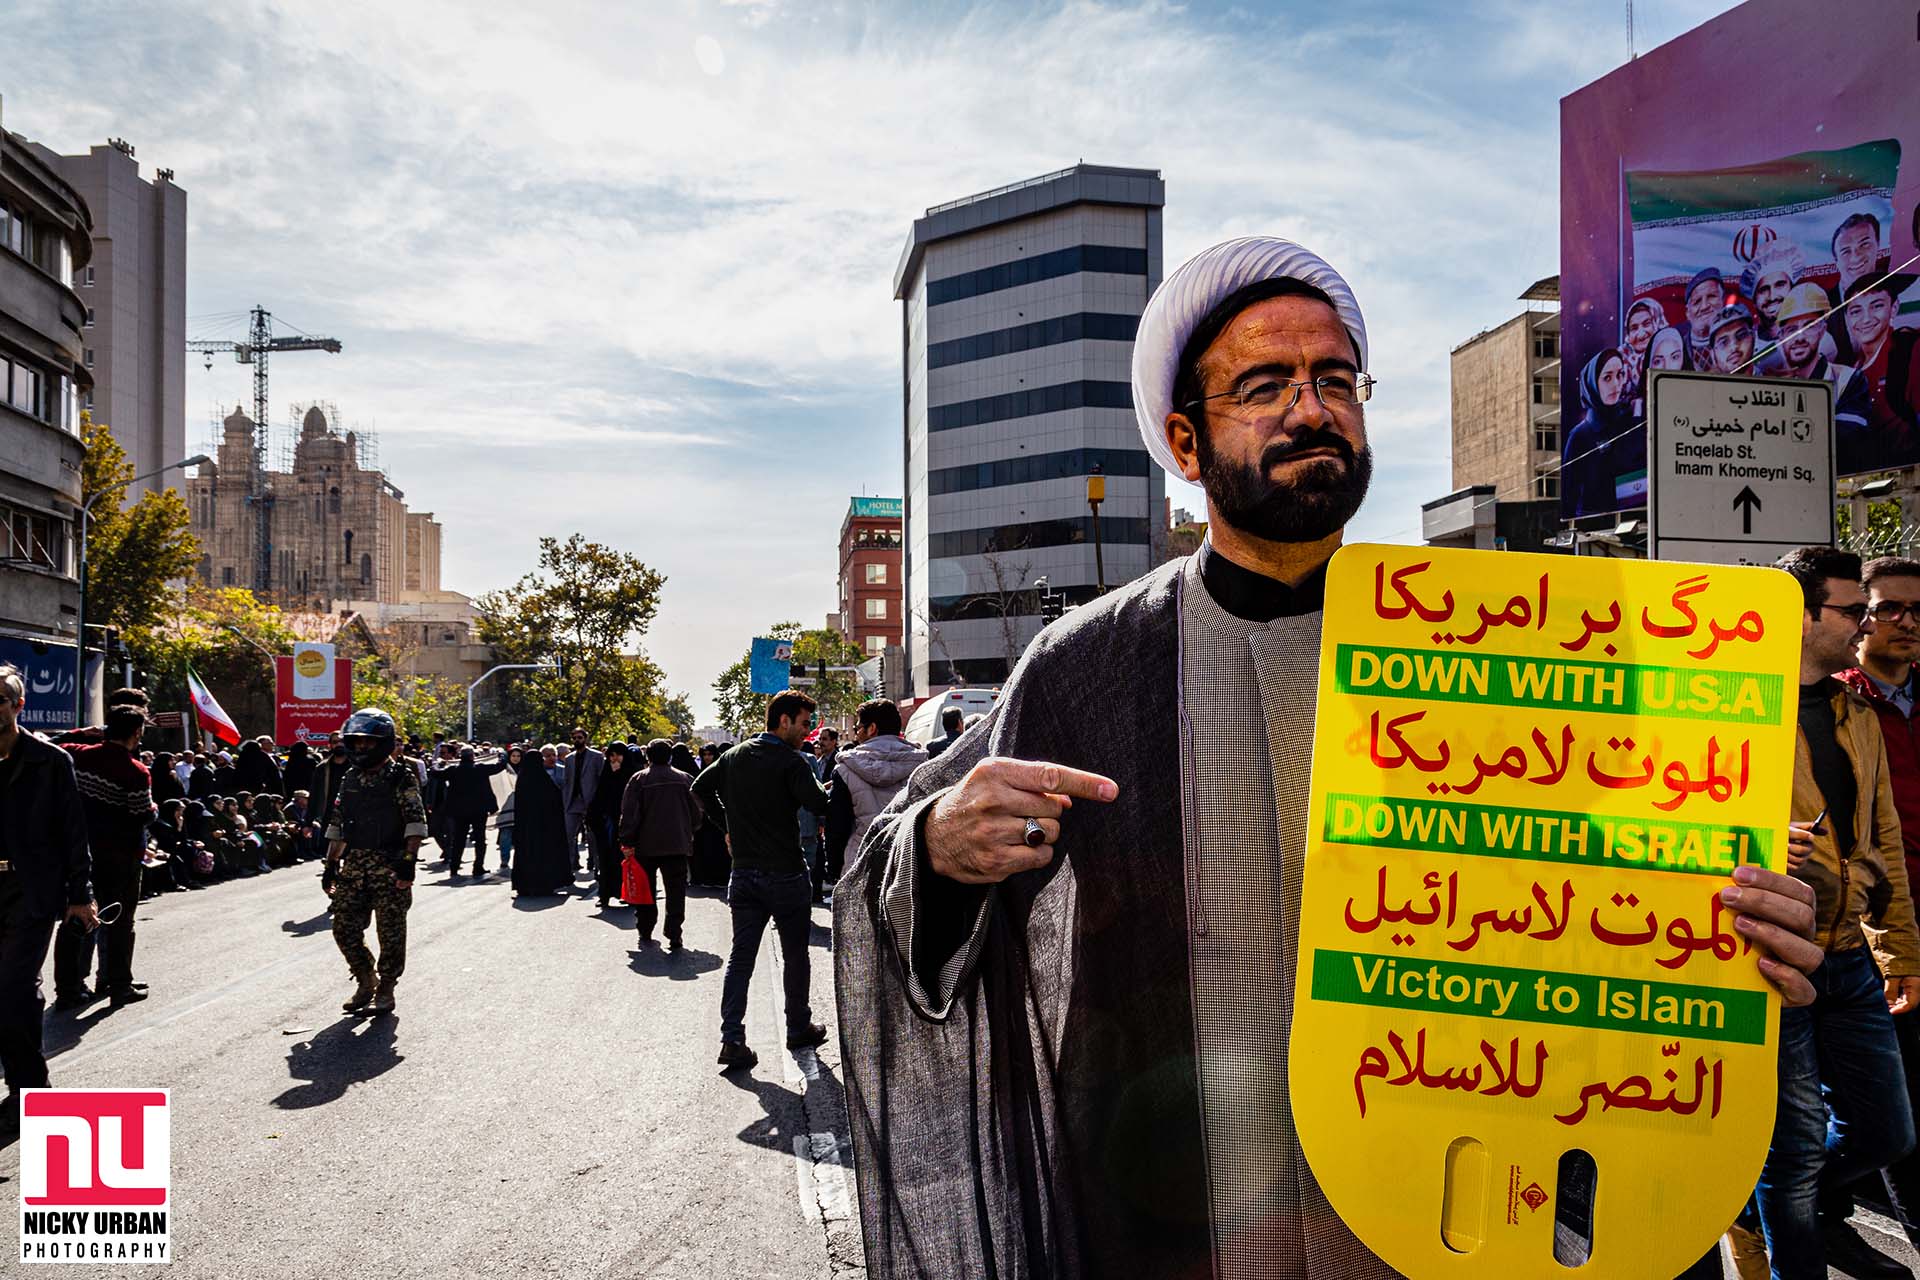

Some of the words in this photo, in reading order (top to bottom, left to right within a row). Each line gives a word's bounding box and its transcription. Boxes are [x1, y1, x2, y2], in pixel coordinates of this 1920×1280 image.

[1692, 417, 1745, 438] خمینی
[1729, 391, 1786, 409] انقلاب
[1750, 419, 1786, 441] امام
[1675, 442, 1733, 459] Enqelab
[1737, 445, 1756, 460] St.
[1675, 461, 1713, 476] Imam
[1719, 463, 1788, 482] Khomeyni
[1793, 466, 1816, 484] Sq.
[1374, 561, 1549, 646] امریکا
[1560, 600, 1622, 657] بر
[1642, 575, 1765, 660] مرگ
[1350, 650, 1490, 697] DOWN
[1507, 661, 1625, 706] WITH
[1642, 670, 1767, 718] U.S.A
[1587, 736, 1750, 811] الموت
[1333, 799, 1467, 846] DOWN
[1481, 812, 1588, 856] WITH
[1603, 821, 1760, 869] ISRAEL
[1352, 956, 1519, 1016] Victory
[1534, 976, 1580, 1013] to
[1597, 980, 1725, 1029] Islam
[1353, 1028, 1549, 1120] للاسلام
